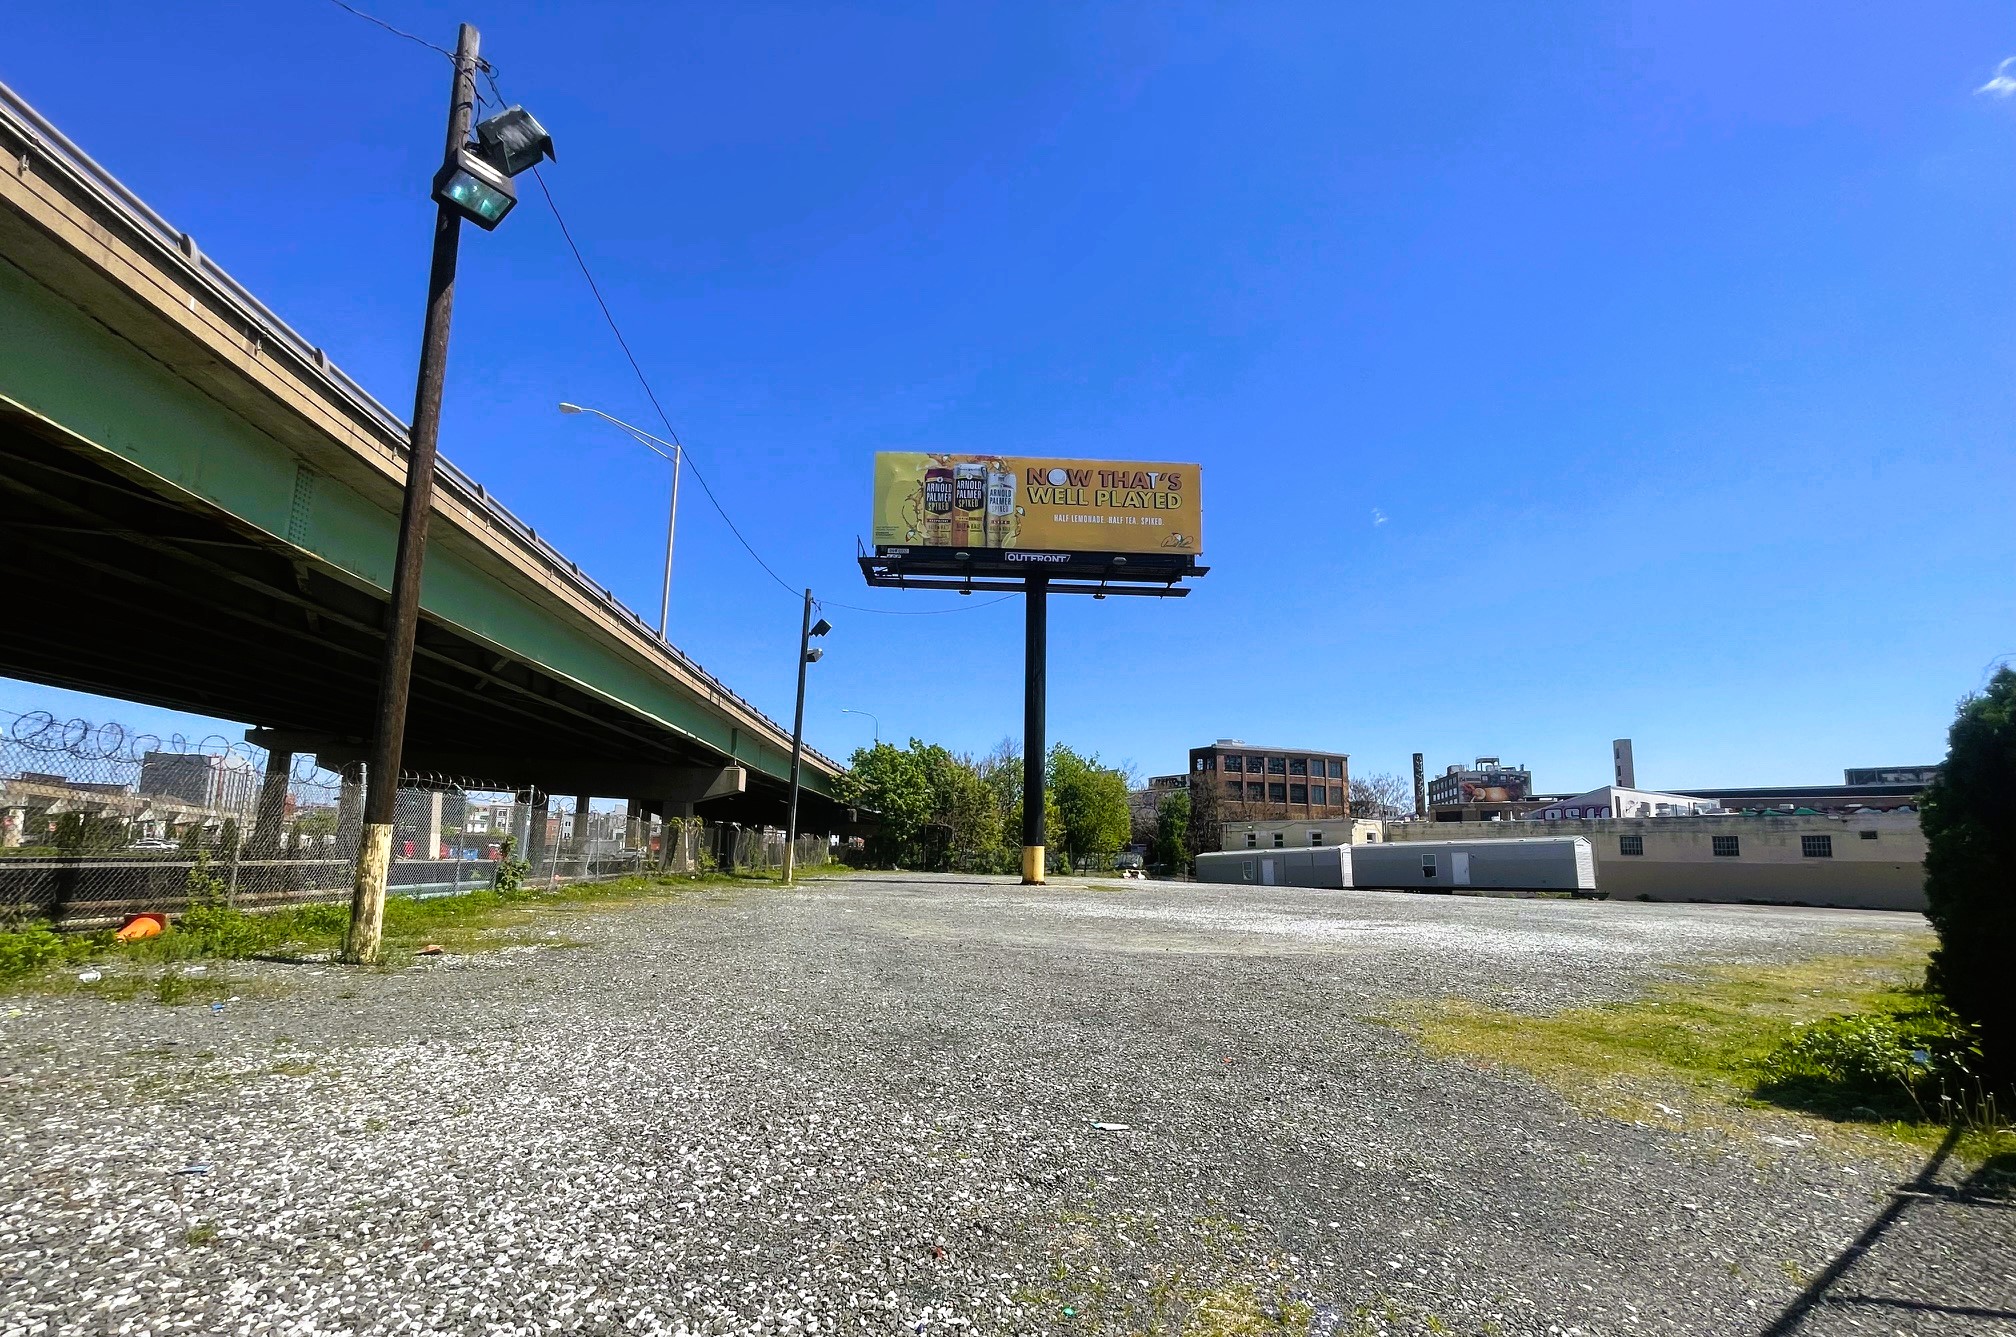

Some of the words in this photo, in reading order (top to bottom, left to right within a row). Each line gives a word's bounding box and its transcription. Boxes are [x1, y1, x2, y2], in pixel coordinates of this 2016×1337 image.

[1027, 467, 1093, 487] NOW
[1098, 470, 1183, 491] THAT'S
[926, 483, 952, 493] ARNOLD
[956, 480, 982, 490] ARNOLD
[926, 492, 952, 502] PALMER
[956, 490, 982, 499] PALMER
[989, 489, 1012, 498] ARNOLD
[1027, 487, 1089, 506] WELL
[1095, 490, 1183, 509] PLAYED
[958, 499, 979, 508] SPIKED
[989, 497, 1012, 505] PALMER
[928, 502, 949, 511] SPIKED
[991, 505, 1009, 513] SPIKED
[1054, 514, 1069, 522] HALF
[1108, 516, 1124, 524] HALF
[1007, 553, 1067, 562] OUTFRONT
